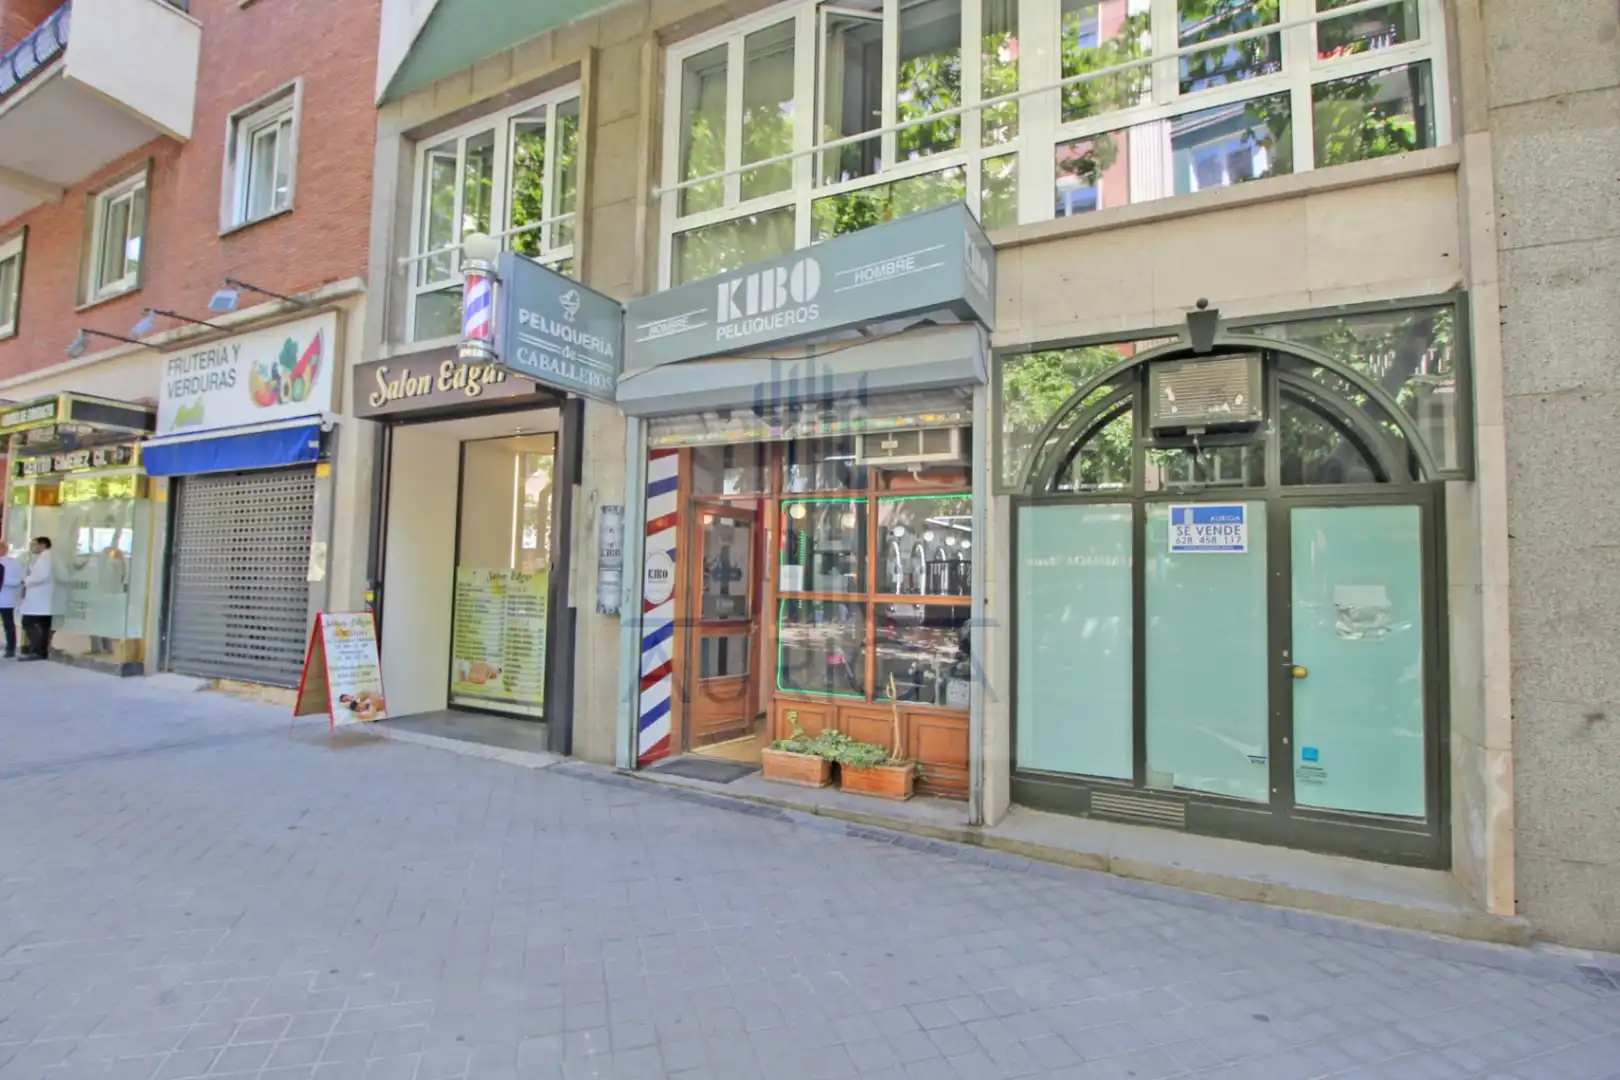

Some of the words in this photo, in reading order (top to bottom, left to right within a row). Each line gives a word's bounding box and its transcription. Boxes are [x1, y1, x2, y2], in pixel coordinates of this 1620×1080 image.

[854, 256, 916, 284] HOMBRE
[716, 257, 821, 323] KIBO
[518, 308, 614, 359] PELUQUERÍA
[715, 304, 820, 341] PELUQUEROS
[232, 343, 241, 363] Y
[562, 345, 576, 360] de
[516, 347, 613, 389] CABALLEROS
[167, 368, 237, 399] VERDURAS
[369, 365, 432, 407] Salon
[1175, 536, 1193, 545] 628
[1199, 536, 1217, 544] 458
[1176, 525, 1191, 536] SE
[1195, 524, 1241, 536] VENDE
[647, 568, 669, 579] KIBO
